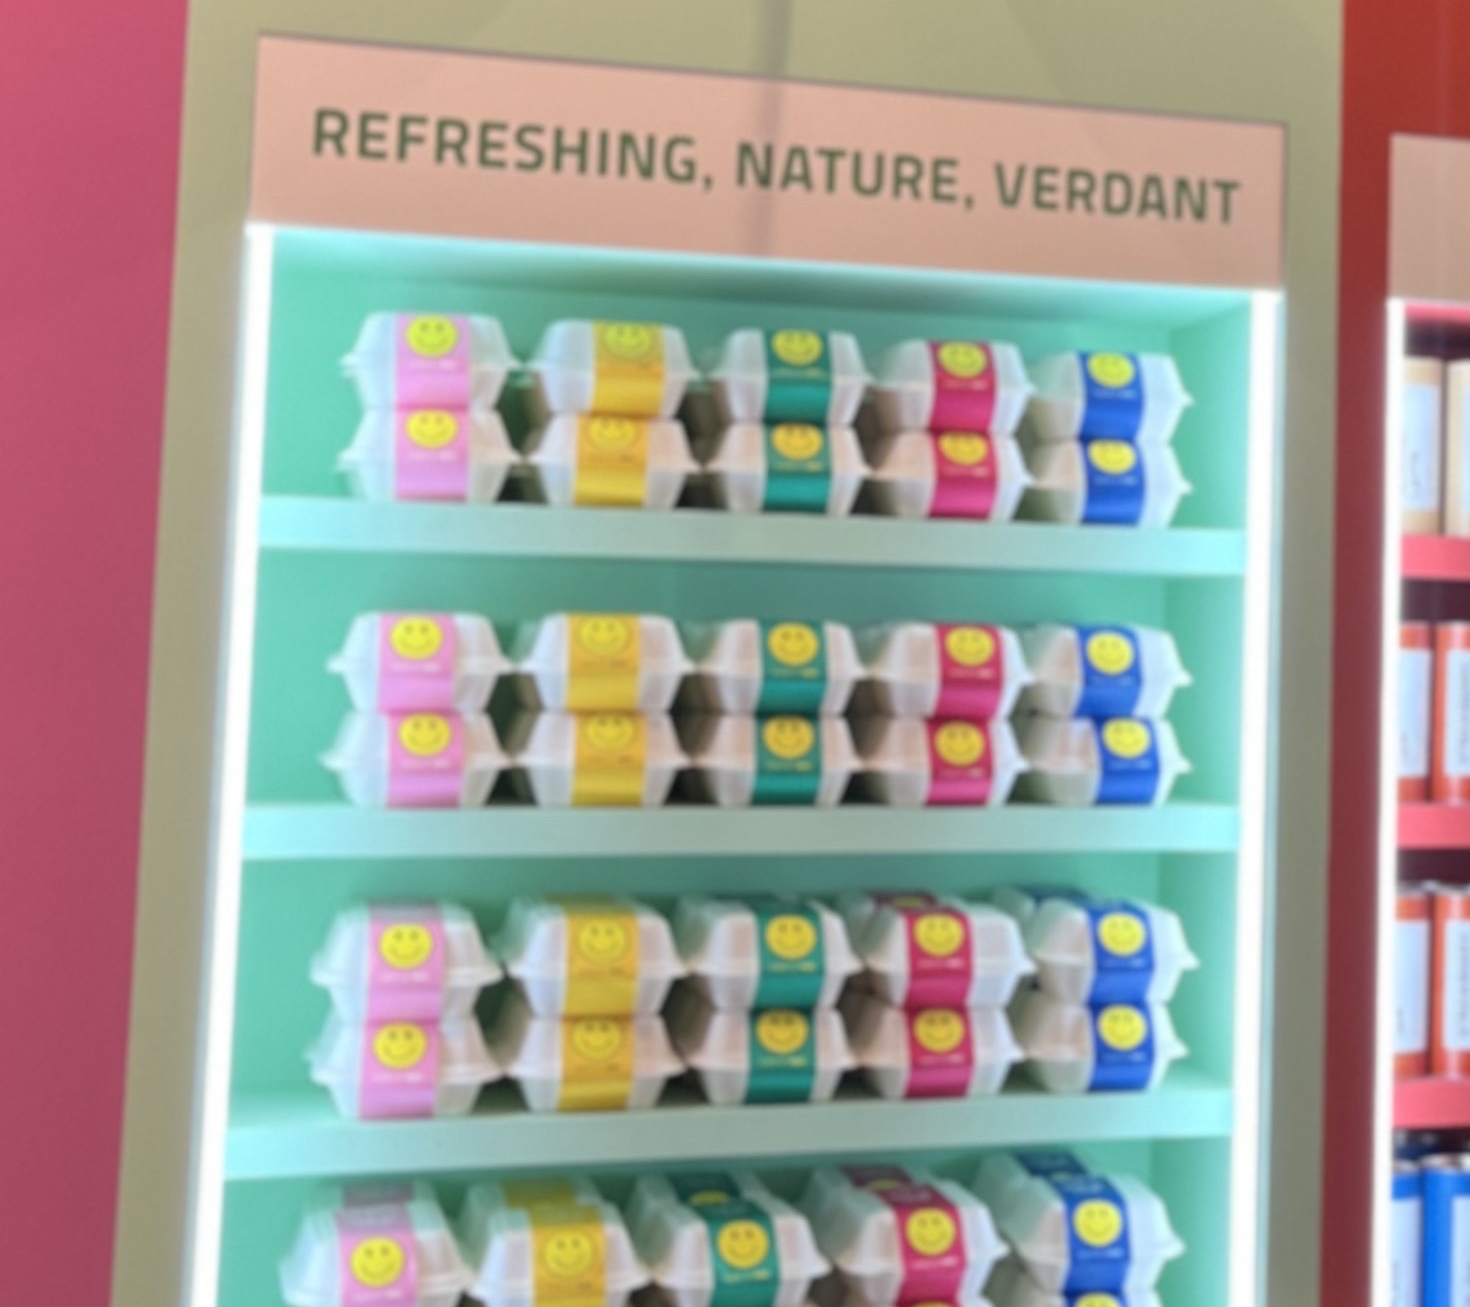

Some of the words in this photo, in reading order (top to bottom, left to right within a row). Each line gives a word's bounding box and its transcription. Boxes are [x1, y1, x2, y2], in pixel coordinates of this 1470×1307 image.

[312, 106, 713, 191] REFRESHING,
[735, 140, 974, 210] NATURE,
[992, 161, 1241, 224] VERDANT
